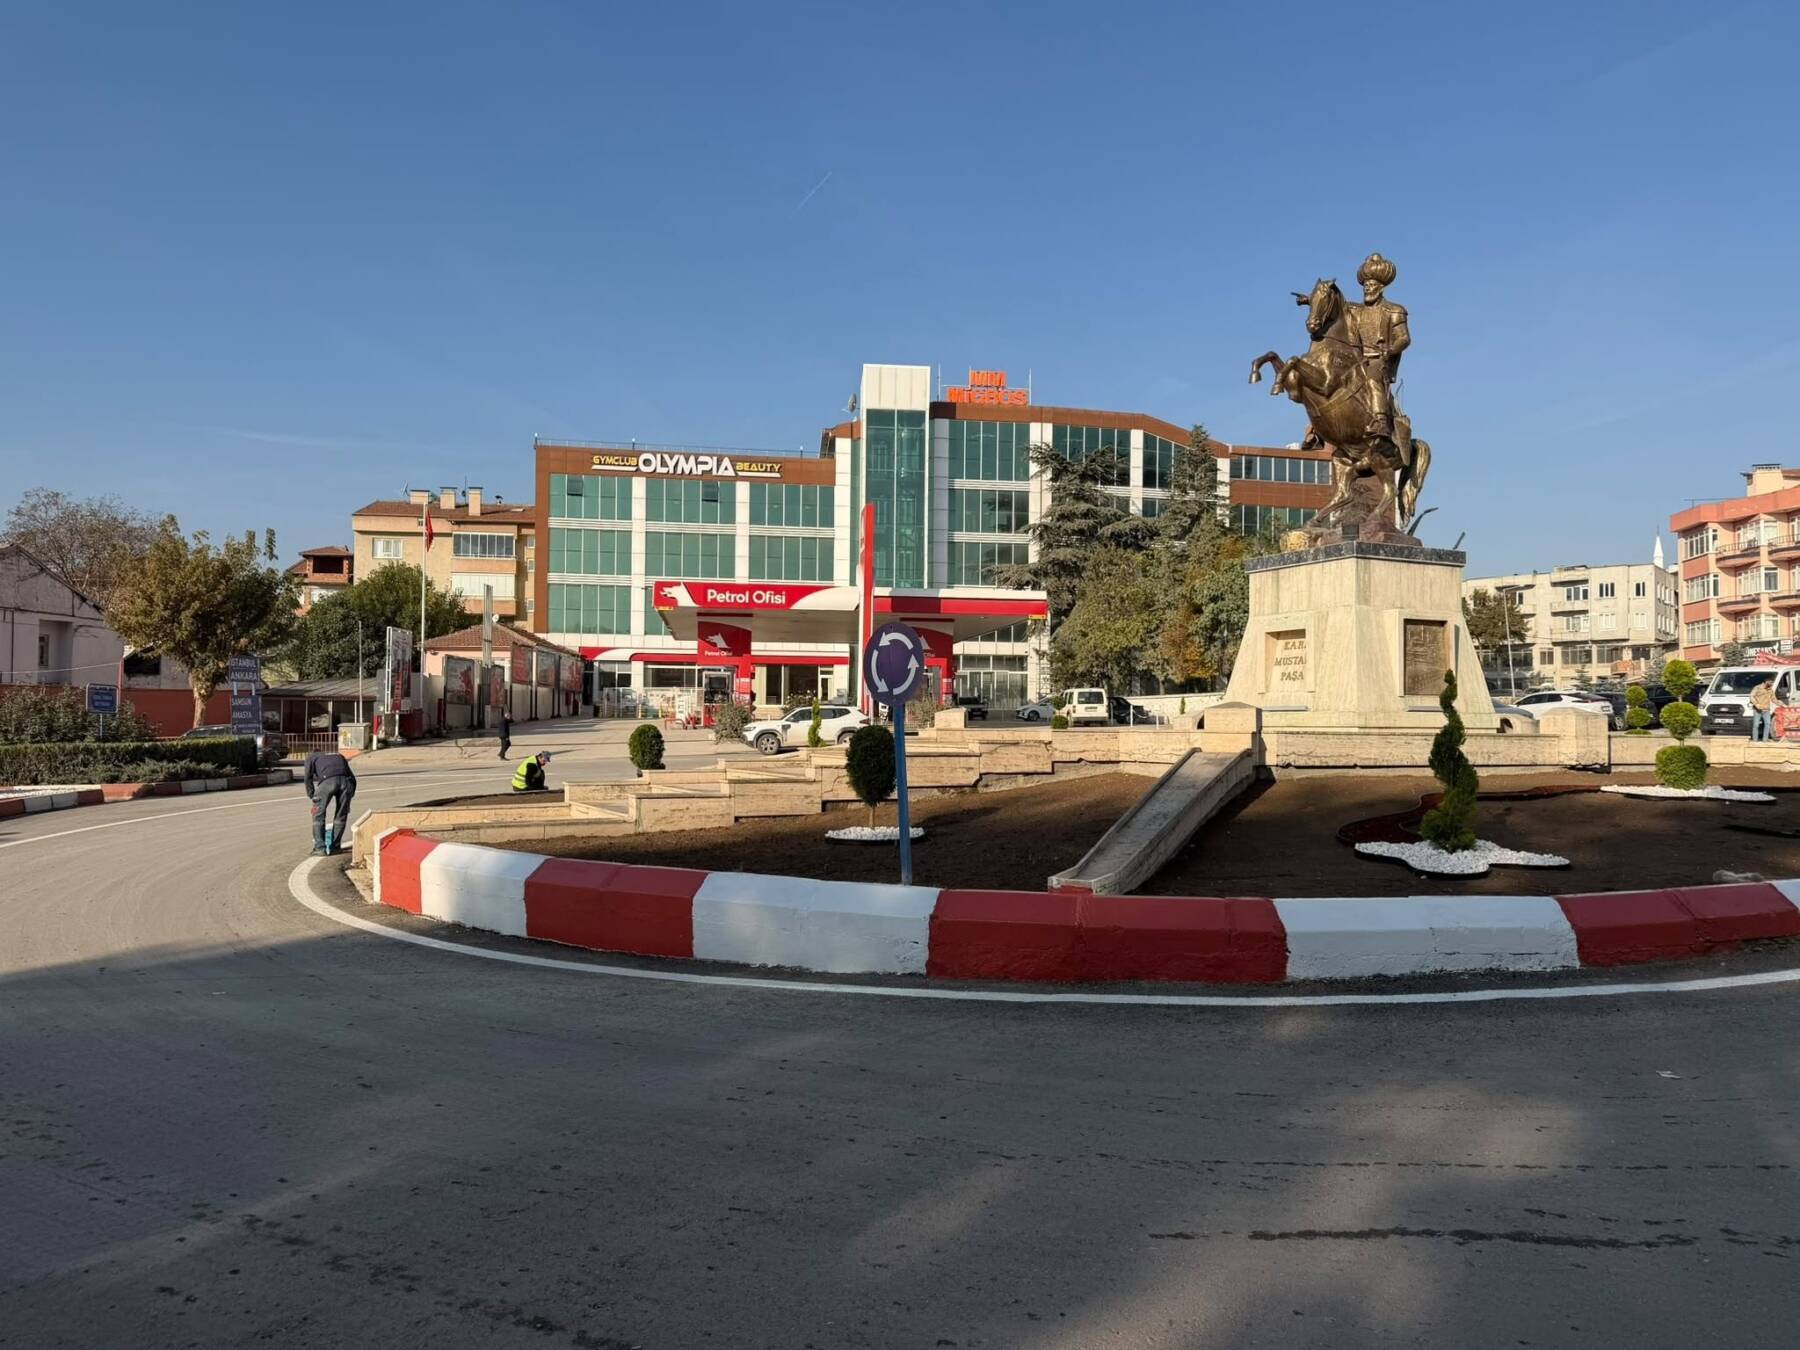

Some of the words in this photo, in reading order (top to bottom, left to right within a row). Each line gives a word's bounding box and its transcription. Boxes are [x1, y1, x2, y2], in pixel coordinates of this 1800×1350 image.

[592, 455, 638, 466] GYMCLUB
[638, 453, 736, 477] OLYMPIA
[736, 462, 781, 472] BEAUTY
[707, 589, 749, 603] Petrol
[752, 590, 786, 604] Ofisi
[230, 671, 257, 680] ANKARA
